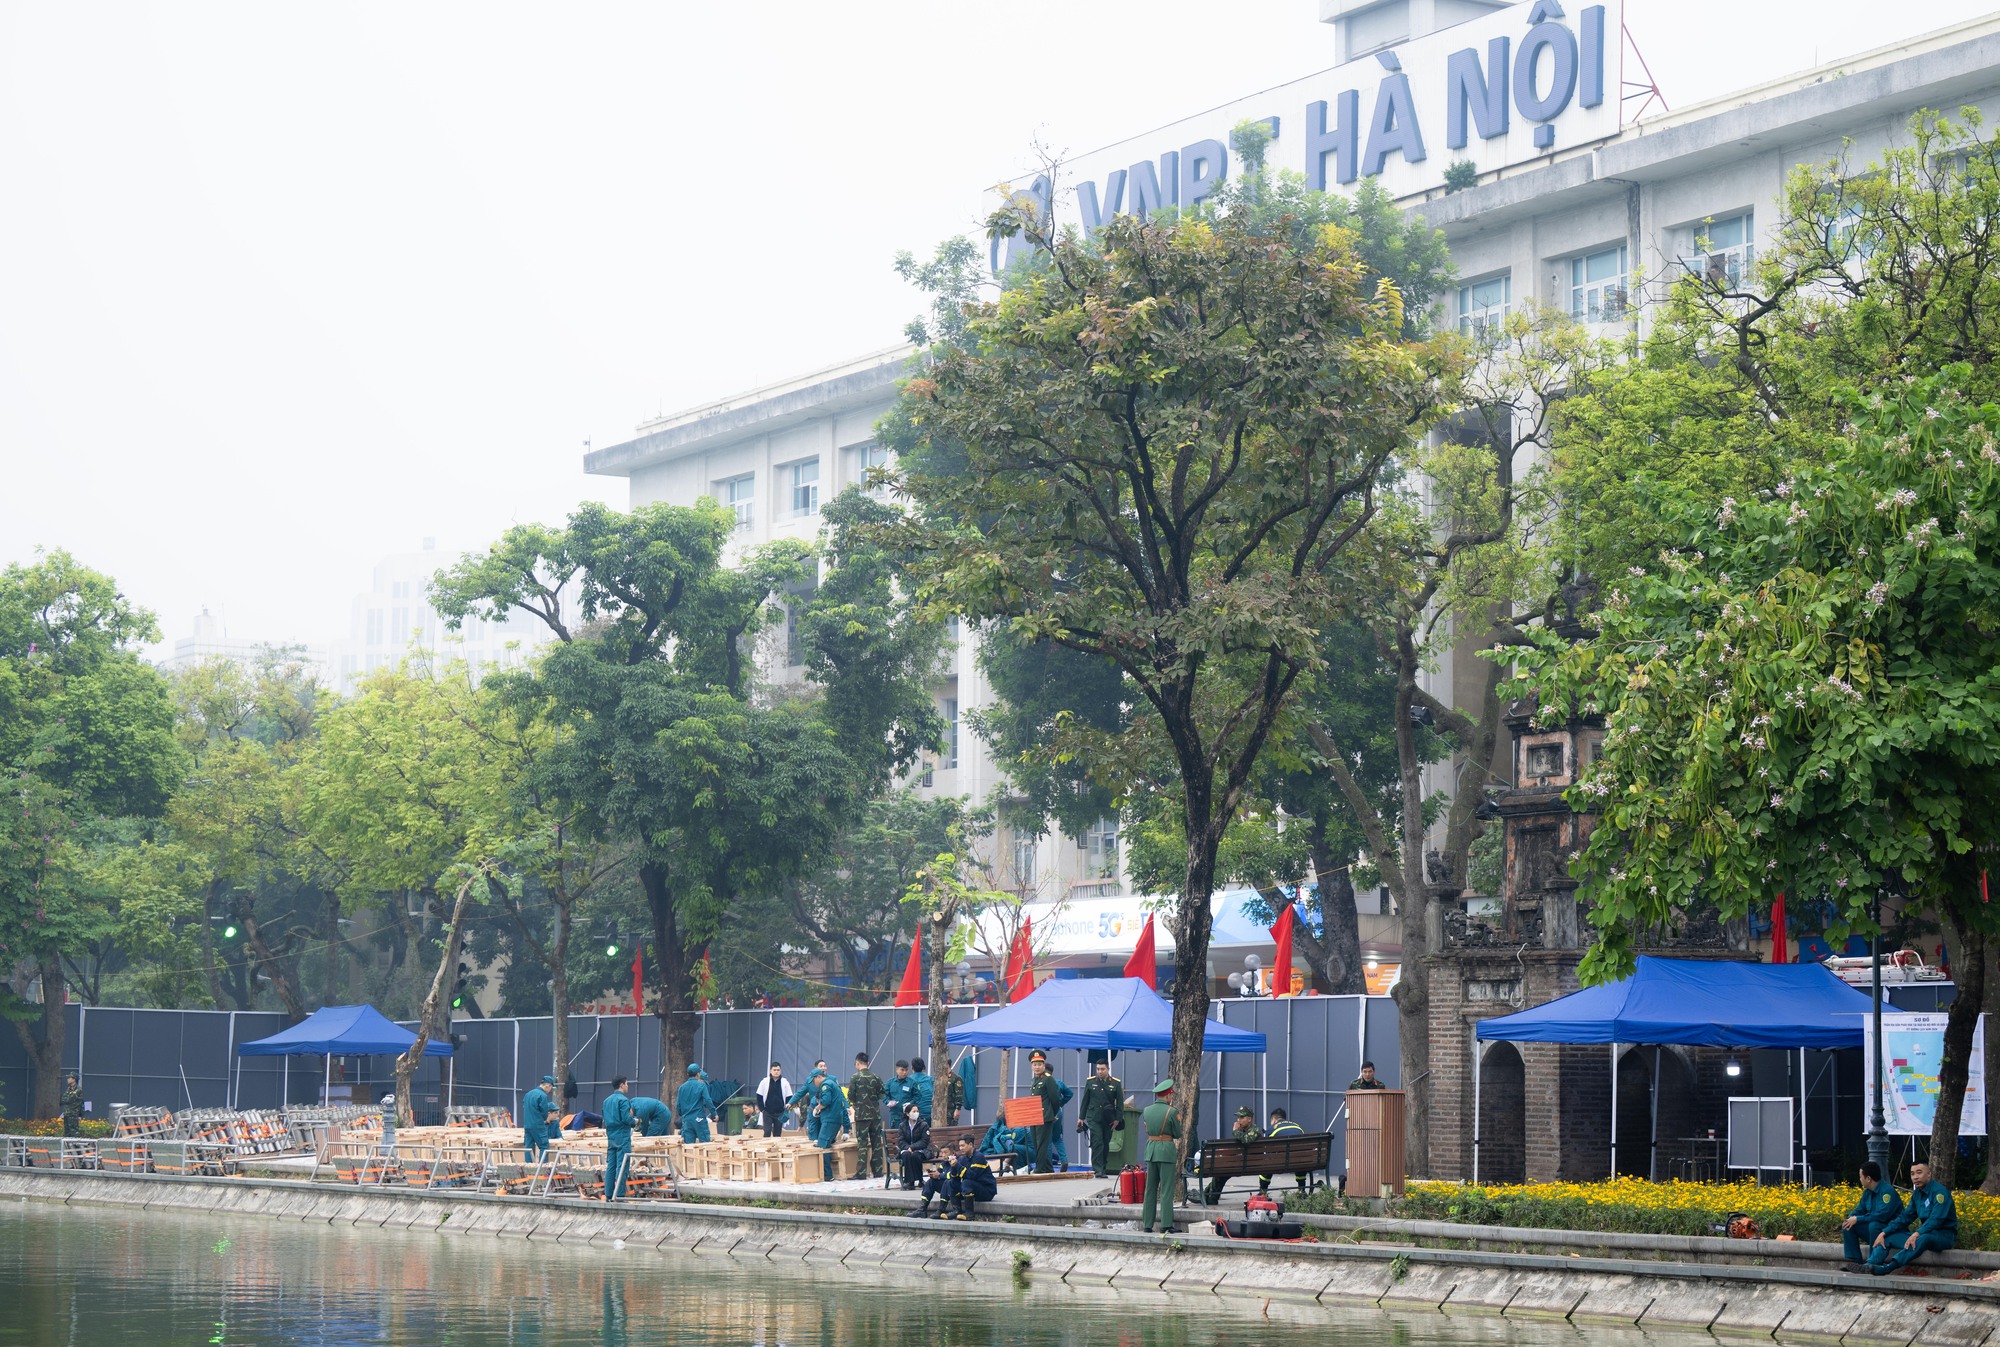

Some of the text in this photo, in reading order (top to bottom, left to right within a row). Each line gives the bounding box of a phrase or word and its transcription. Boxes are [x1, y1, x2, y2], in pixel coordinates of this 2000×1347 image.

[1076, 0, 1605, 241] VNPT HÀ NỘI
